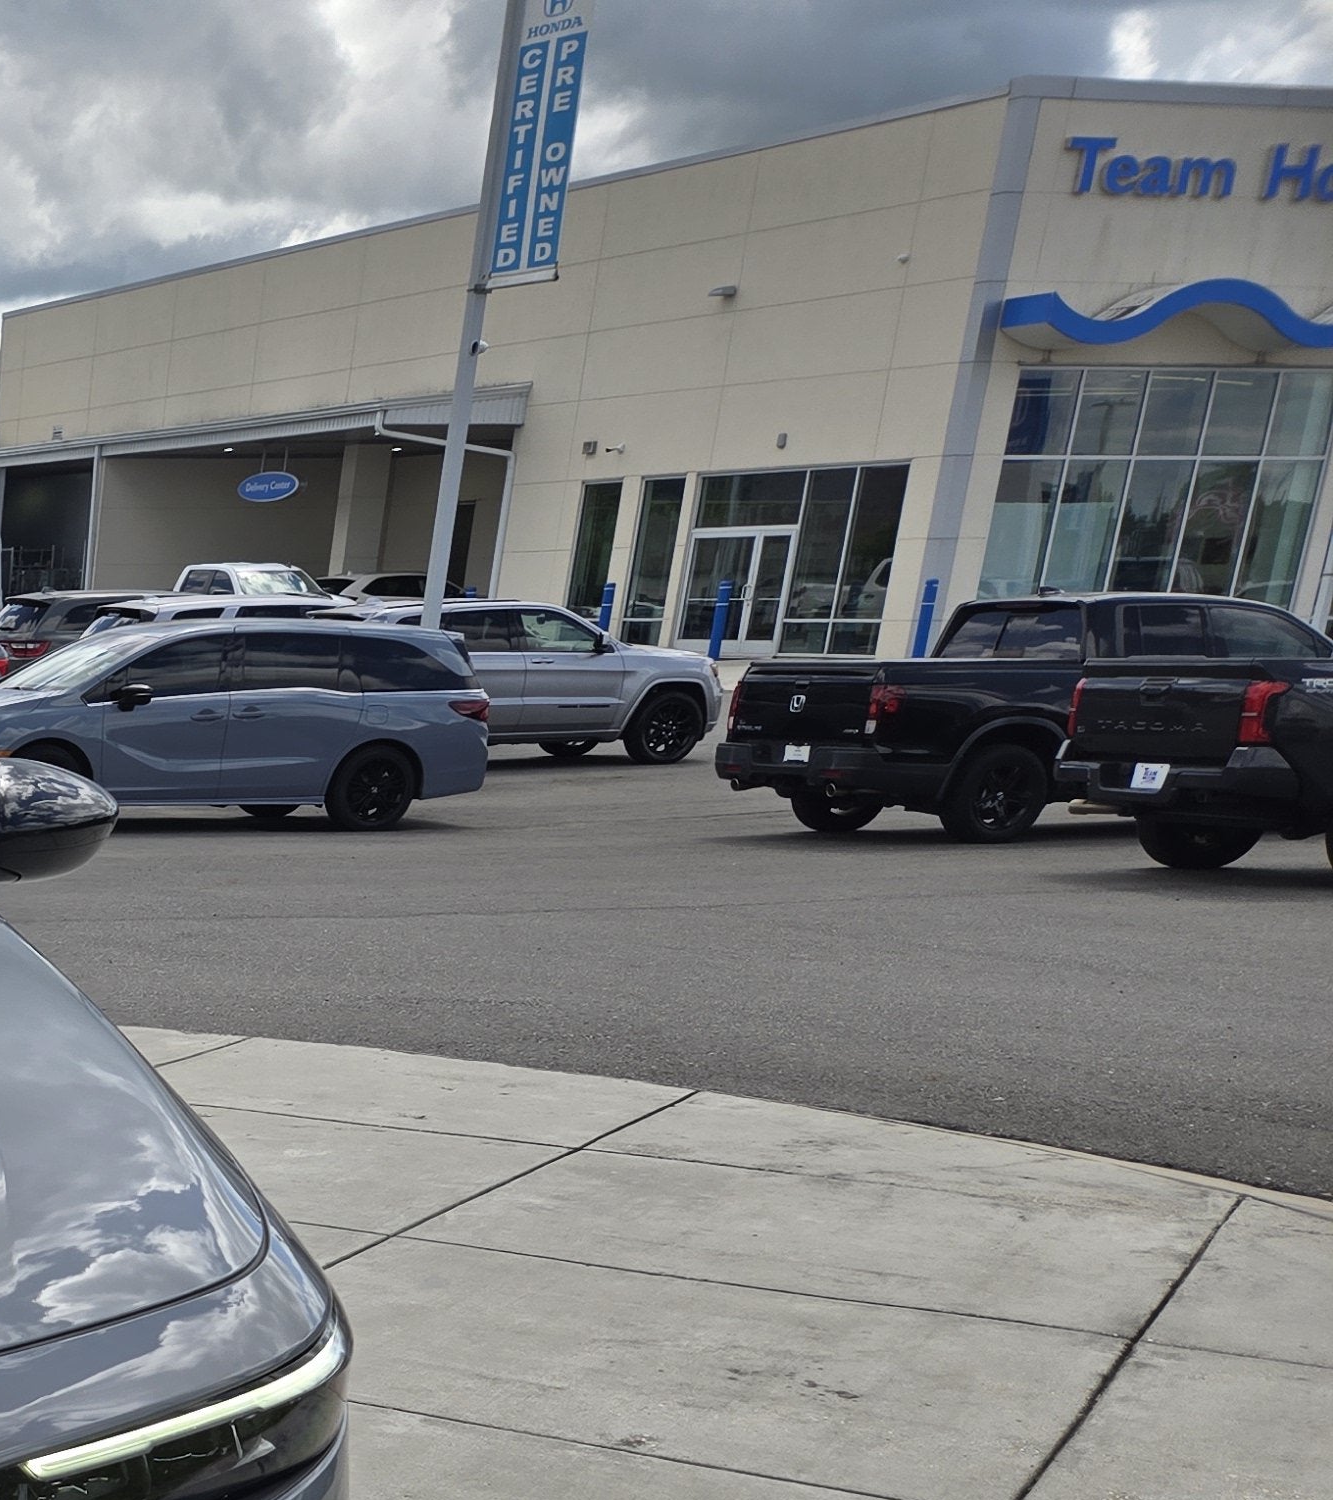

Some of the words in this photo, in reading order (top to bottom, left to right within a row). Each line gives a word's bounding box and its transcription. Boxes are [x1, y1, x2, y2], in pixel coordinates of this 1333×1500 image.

[527, 16, 583, 39] HONDA
[552, 39, 579, 113] PRE
[496, 48, 543, 269] CERTIFIED
[1067, 136, 1237, 196] Team
[534, 142, 566, 263] OWNED
[245, 482, 269, 493] Delivery
[270, 480, 291, 490] Center
[1097, 719, 1208, 733] TACOMA
